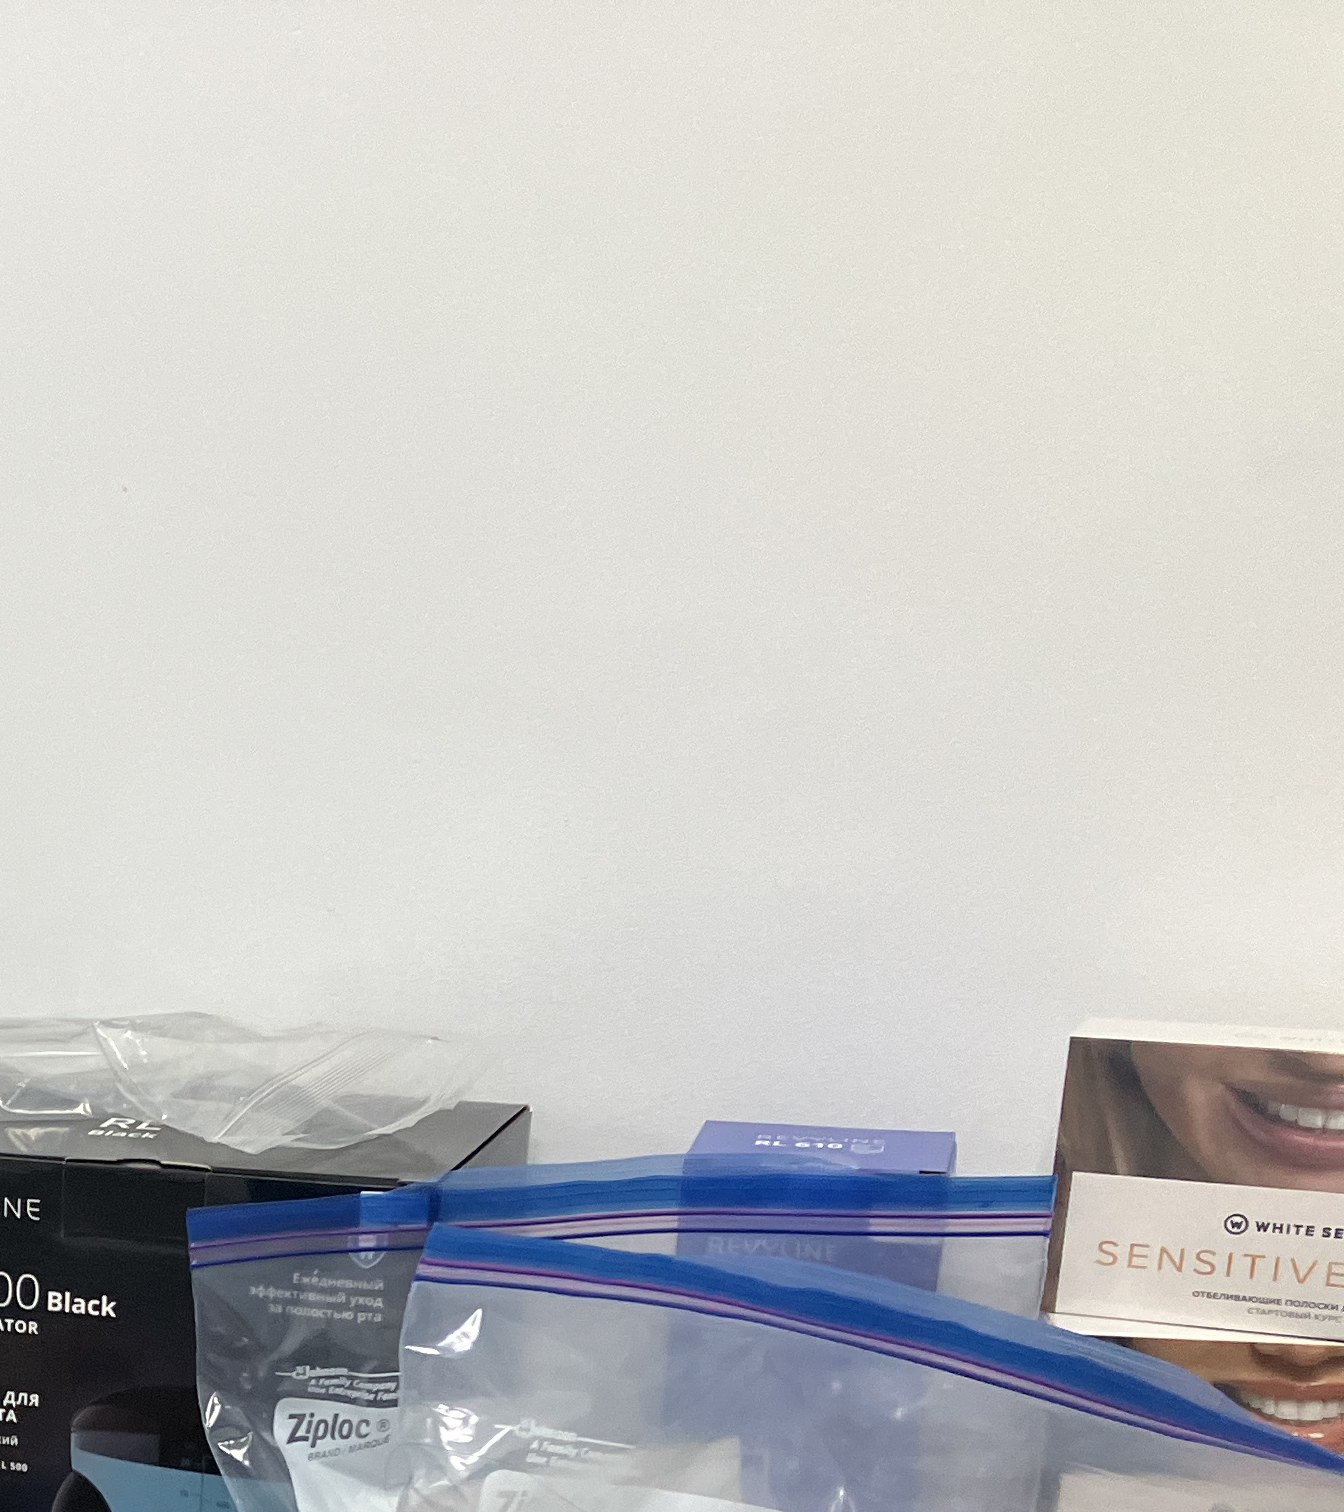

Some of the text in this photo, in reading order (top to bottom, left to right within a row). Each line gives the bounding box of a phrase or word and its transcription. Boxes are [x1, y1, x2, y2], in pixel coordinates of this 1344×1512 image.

[1255, 1221, 1315, 1237] WHITE
[1095, 1240, 1344, 1288] SENSITIVE
[47, 1290, 117, 1318] Black
[349, 1297, 384, 1309] уход
[1192, 1290, 1339, 1311] ОТБЕЛИВАЮЩИЕ ПОЛОСКИ
[357, 1312, 382, 1324] рта
[1247, 1307, 1311, 1320] СТАРТОВЫЙ
[3, 1390, 40, 1408] ДЛЯ
[286, 1412, 370, 1448] Ziploc
[10, 1461, 28, 1473] 500
